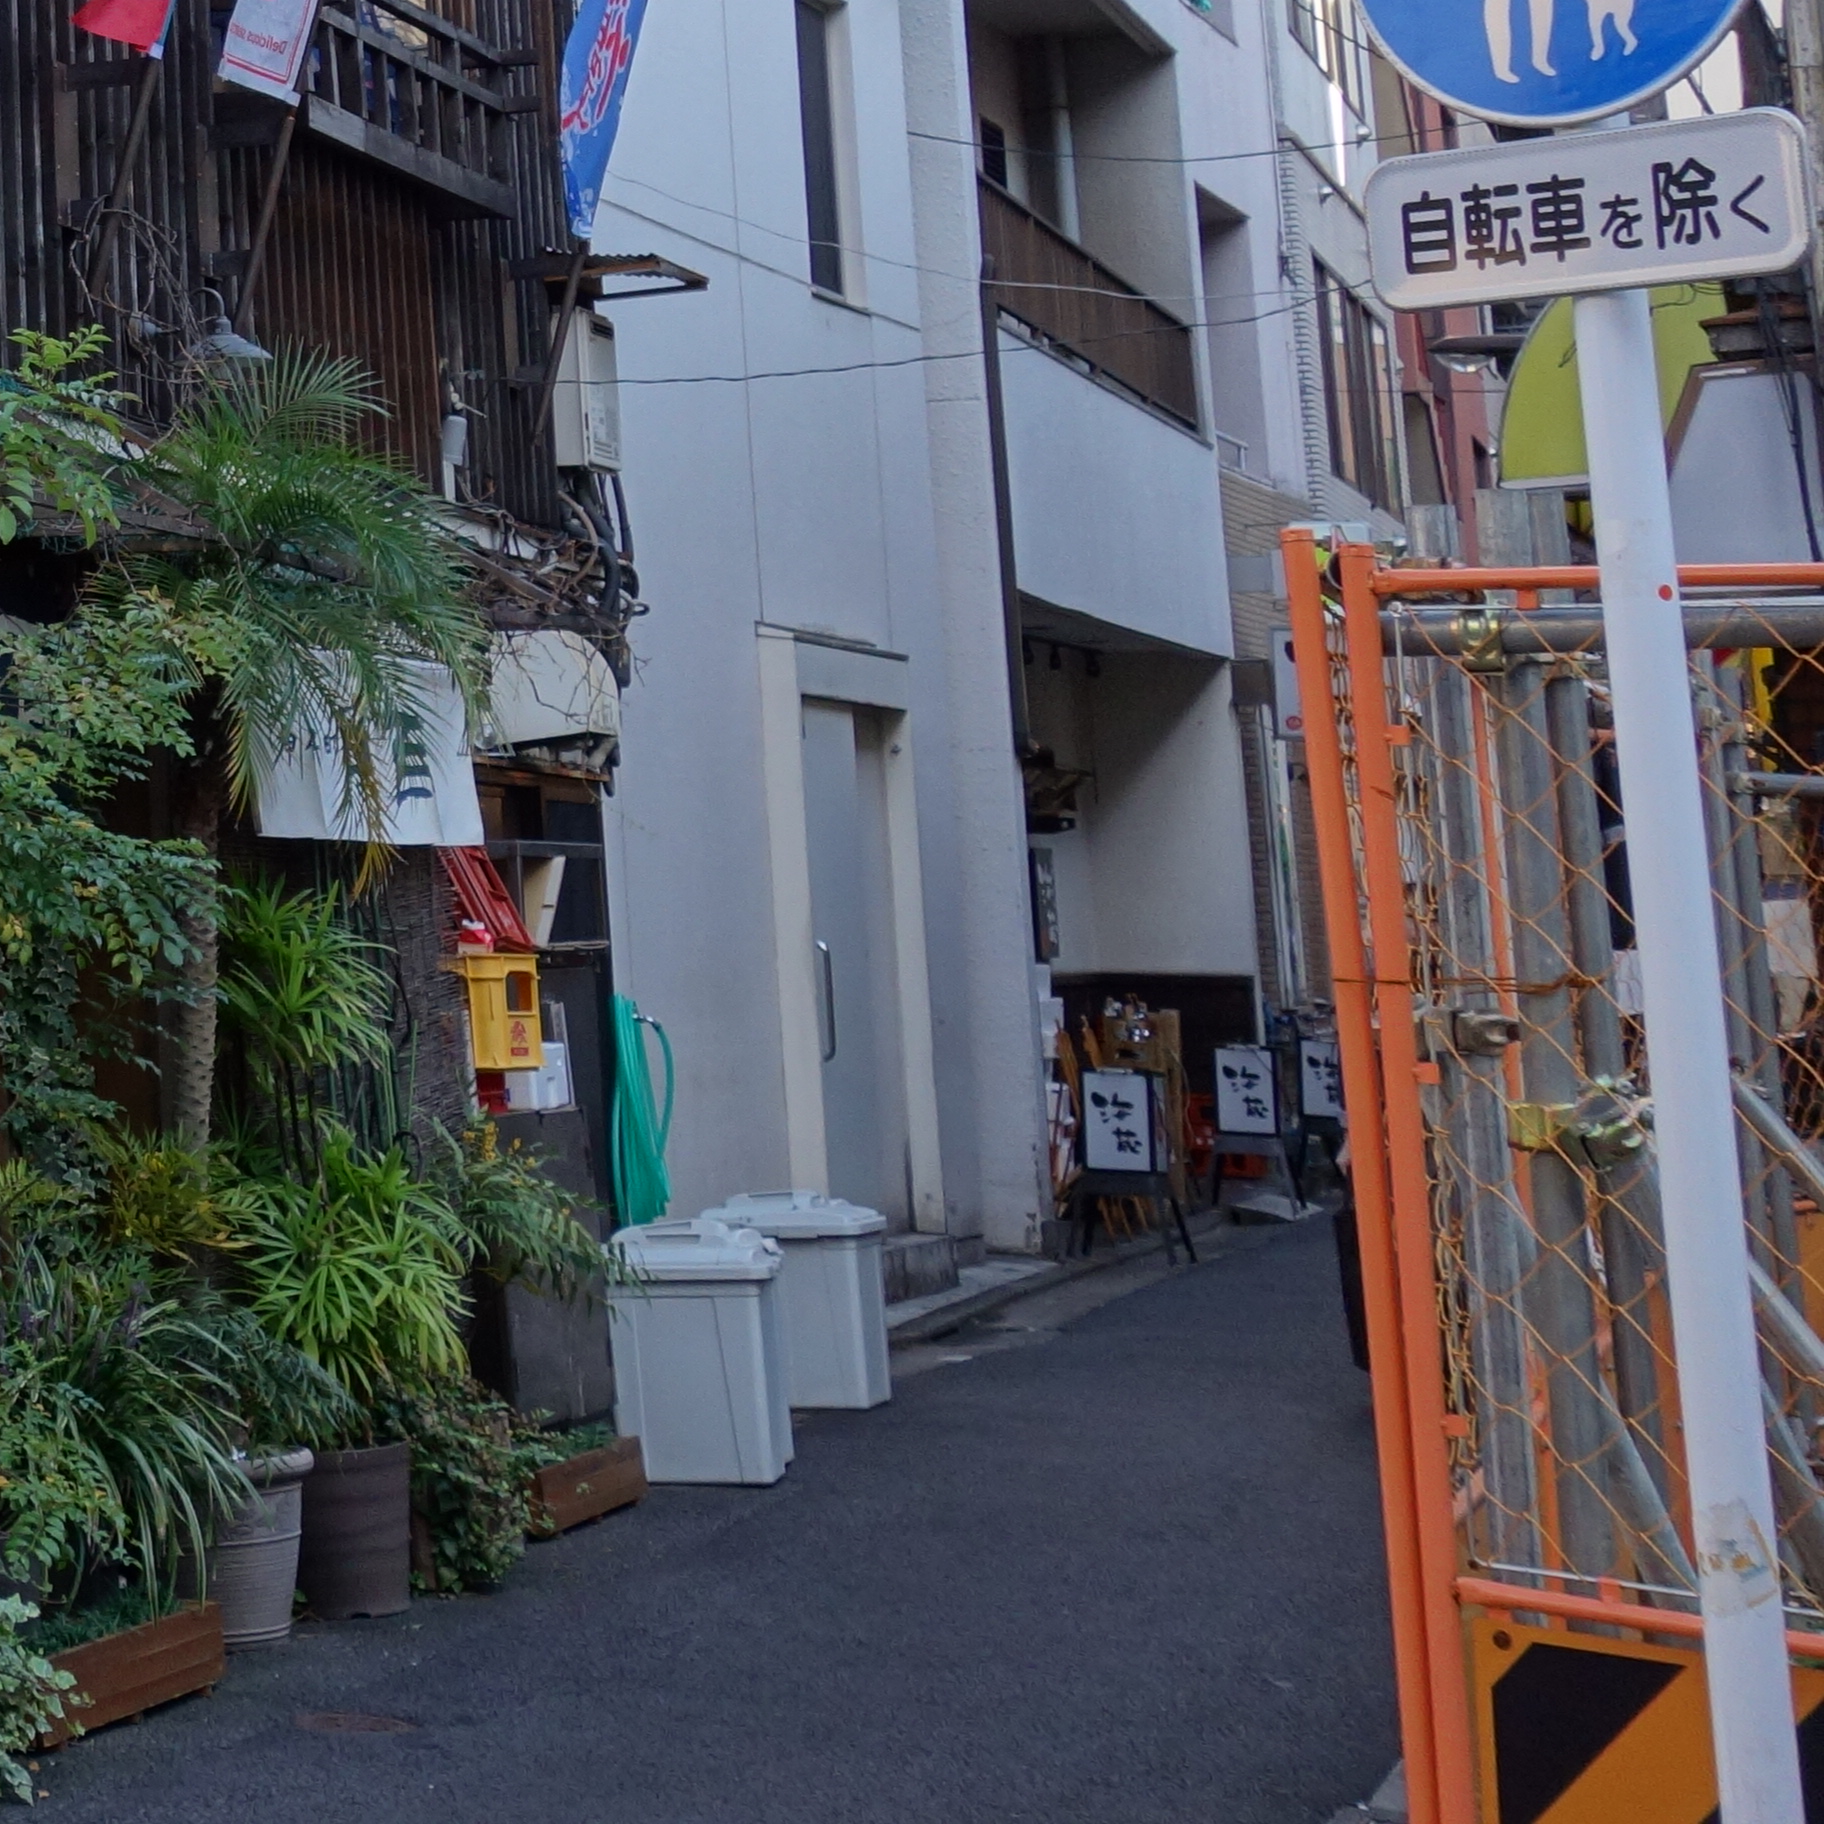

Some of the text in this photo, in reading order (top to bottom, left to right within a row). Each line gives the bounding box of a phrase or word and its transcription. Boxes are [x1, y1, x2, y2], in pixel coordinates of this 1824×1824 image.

[1402, 156, 1770, 276] 自転車を除く
